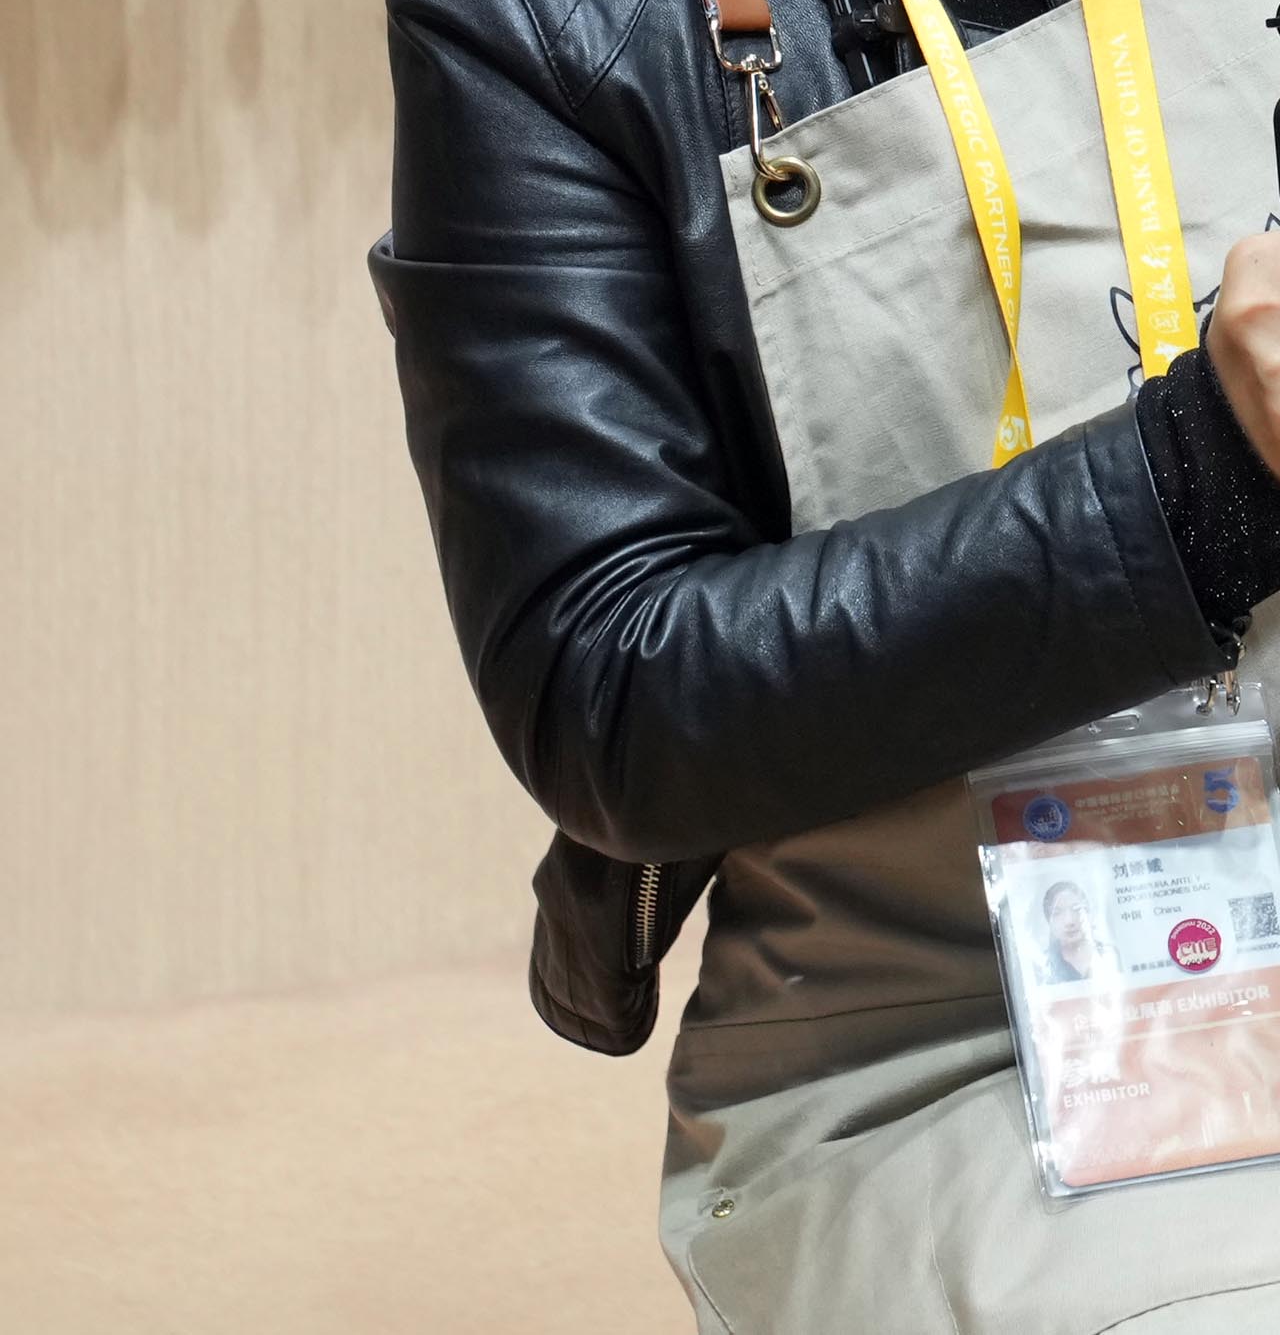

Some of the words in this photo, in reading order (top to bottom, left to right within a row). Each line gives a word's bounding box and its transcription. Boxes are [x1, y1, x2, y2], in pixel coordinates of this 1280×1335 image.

[1110, 32, 1141, 117] CHINA
[926, 15, 989, 154] STRATEGIC
[976, 161, 1014, 289] PARTNER
[1124, 126, 1148, 157] OF
[1132, 163, 1162, 232] BANK
[1203, 768, 1239, 813] 5
[1153, 905, 1182, 916] China
[1195, 920, 1216, 936] 2022
[1177, 984, 1271, 1013] EXHIBITOR
[1063, 1082, 1151, 1109] EXHIBITOR
